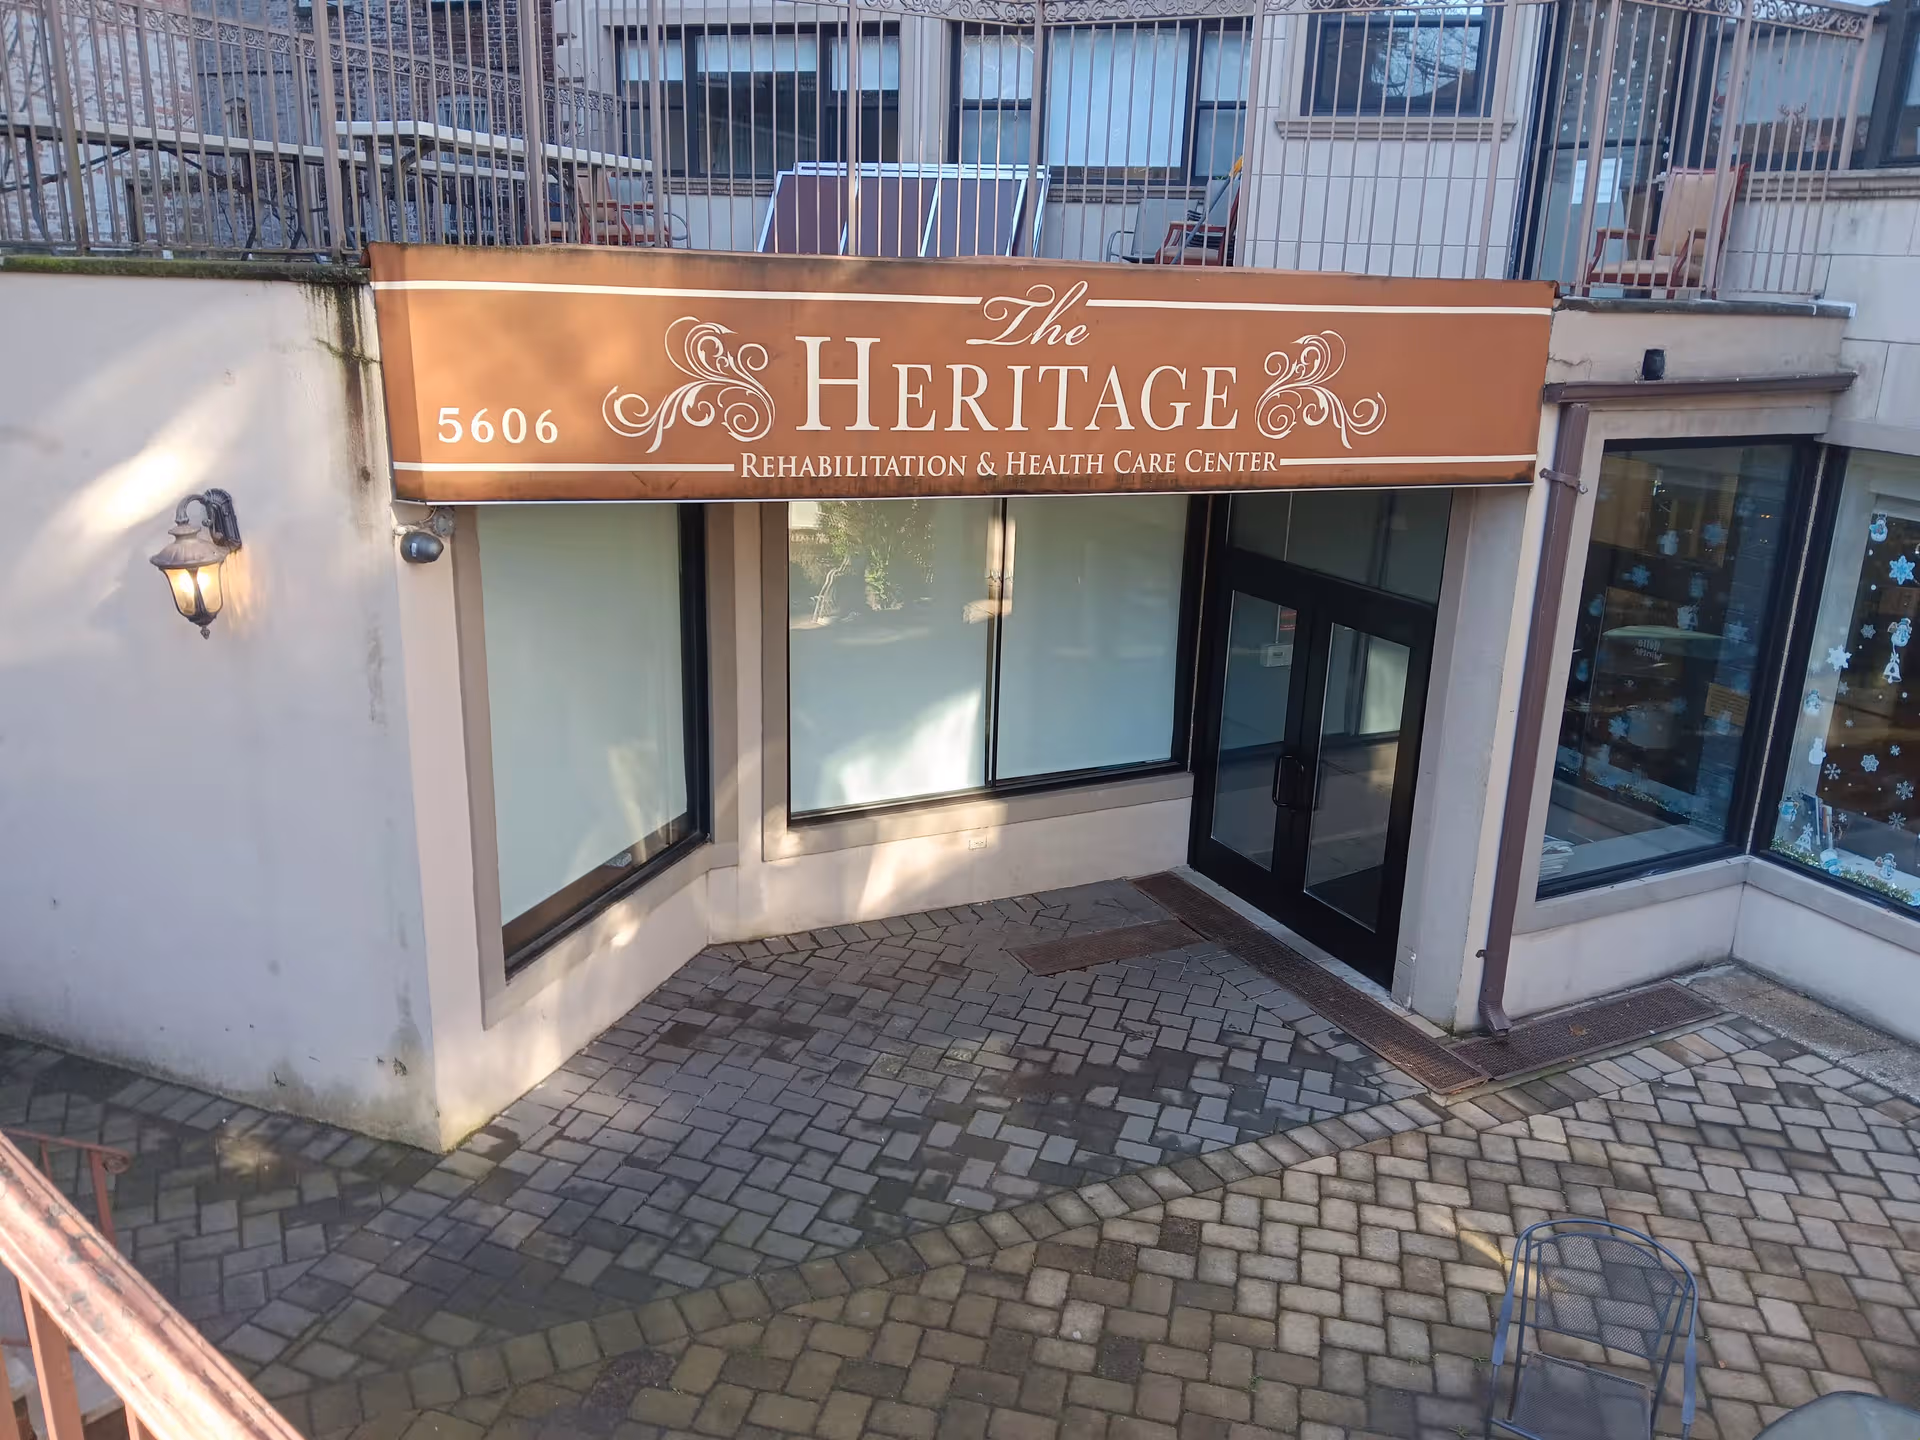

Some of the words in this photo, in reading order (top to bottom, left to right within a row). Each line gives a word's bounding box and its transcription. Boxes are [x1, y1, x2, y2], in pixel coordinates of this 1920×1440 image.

[966, 281, 1089, 346] The
[795, 335, 1239, 431] HERITAGE
[437, 407, 559, 444] 5606
[740, 452, 967, 478] REHABILITATION
[976, 451, 998, 477] &
[1005, 451, 1104, 476] HEALTH
[1113, 449, 1176, 474] CARE
[1184, 449, 1278, 473] CENTER
